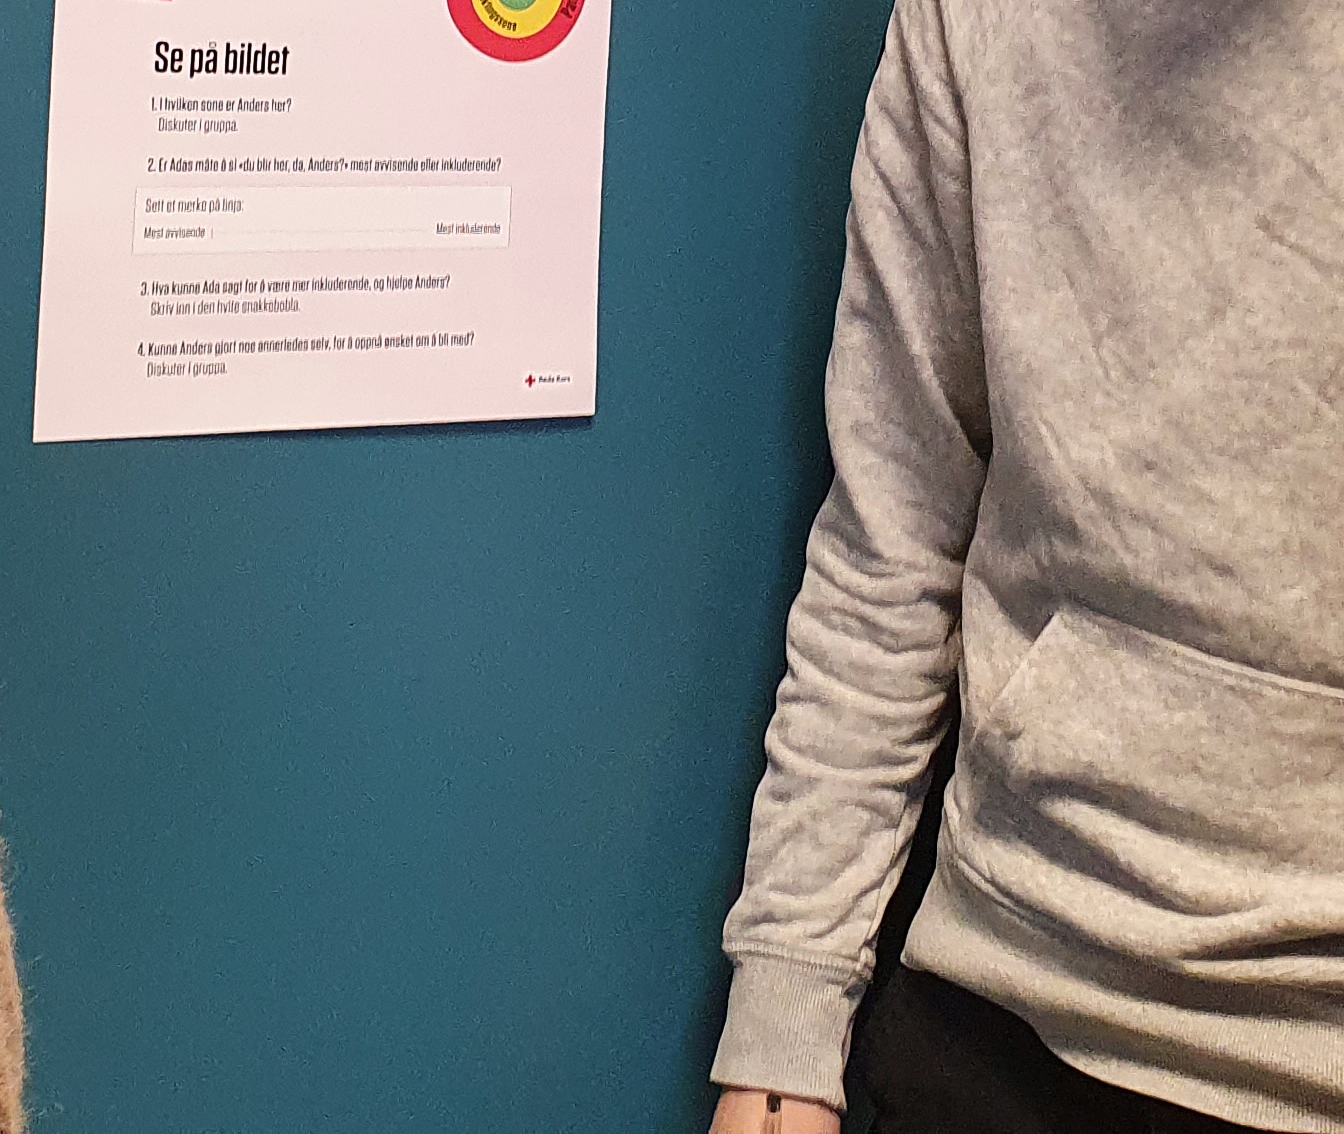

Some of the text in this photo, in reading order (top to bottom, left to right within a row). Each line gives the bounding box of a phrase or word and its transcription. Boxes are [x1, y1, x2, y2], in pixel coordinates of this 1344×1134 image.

[155, 41, 289, 78] Se på bildet
